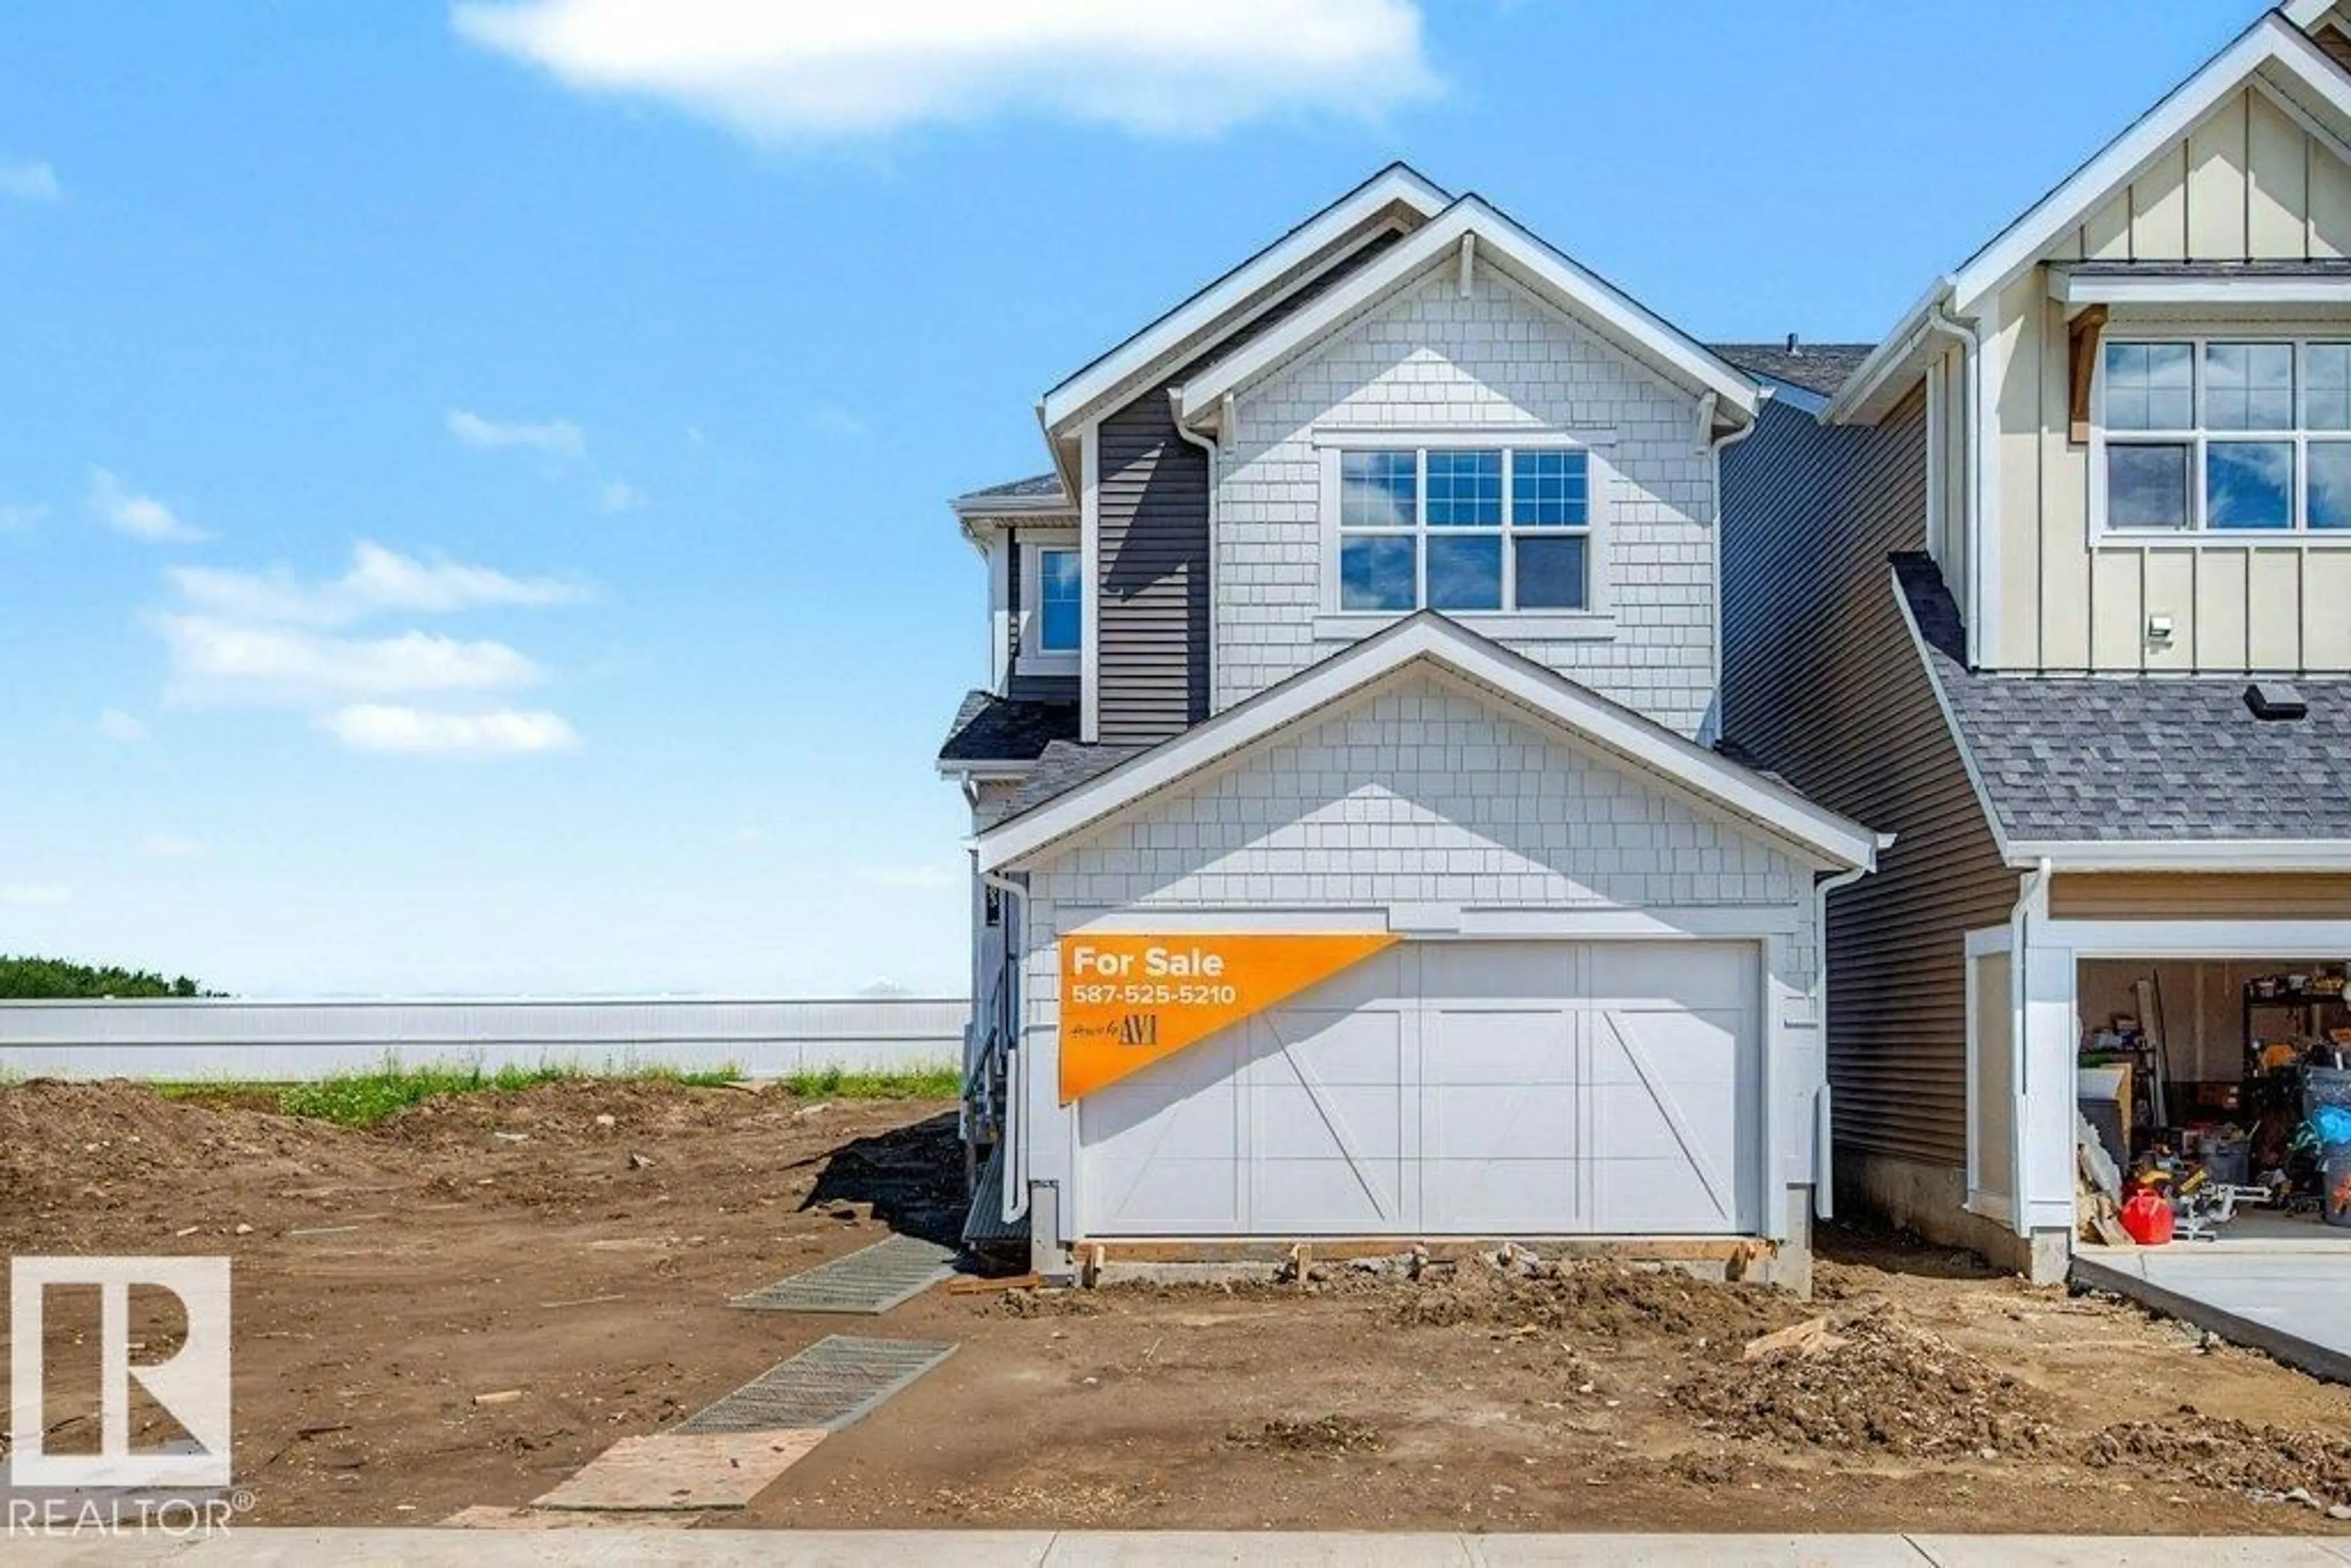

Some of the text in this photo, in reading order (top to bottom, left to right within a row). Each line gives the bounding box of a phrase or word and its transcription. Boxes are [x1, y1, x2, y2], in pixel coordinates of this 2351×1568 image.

[1074, 947, 1224, 977] For Sale
[1073, 985, 1236, 1004] 587-525-5210
[1118, 1015, 1156, 1045] AVI
